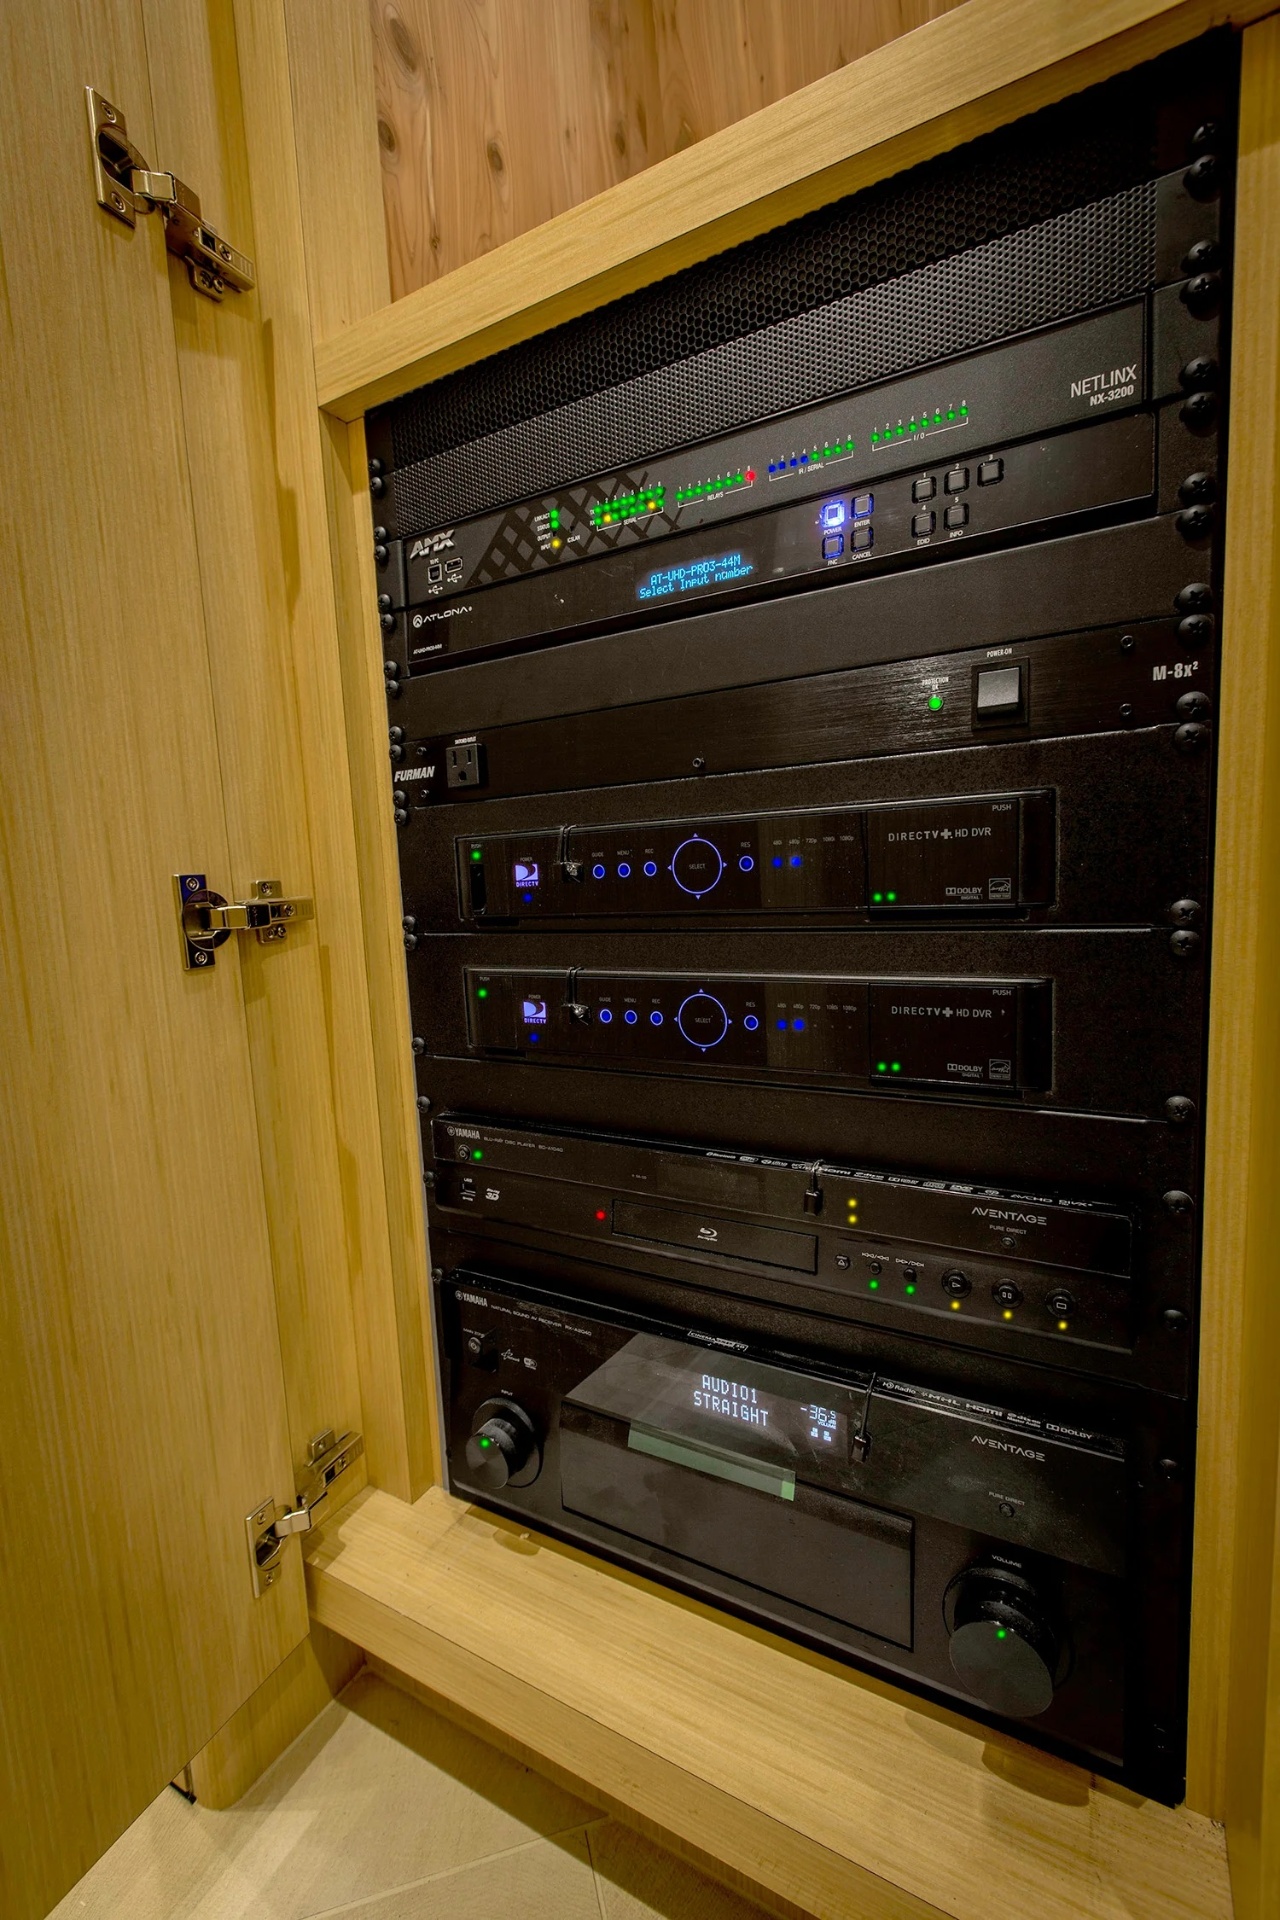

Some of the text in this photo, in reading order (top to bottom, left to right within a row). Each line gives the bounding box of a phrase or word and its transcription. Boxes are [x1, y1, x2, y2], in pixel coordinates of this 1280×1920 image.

[1070, 364, 1137, 398] NETLINX
[1090, 385, 1134, 407] NX-3200
[807, 462, 825, 473] SERIAL
[707, 491, 724, 501] RELAYS
[854, 519, 870, 528] ENTER
[823, 526, 842, 535] POWER
[949, 530, 963, 538] INFO
[409, 529, 455, 559] AMX
[852, 551, 872, 560] CANCEL
[650, 555, 741, 586] AT-UHD-PRO3-44M
[640, 565, 753, 599] Select Input number
[423, 606, 468, 623] ATLONA
[394, 766, 435, 783] FURMAN
[992, 803, 1012, 811] PUSH
[954, 828, 969, 838] HD
[971, 827, 992, 837] DVR
[515, 881, 539, 889] DIRECTV
[956, 1009, 970, 1018] HD
[972, 1009, 993, 1018] DVR
[524, 1017, 547, 1025] DIRECTV
[958, 1064, 983, 1072] DOLBY
[454, 1128, 480, 1140] YAMAHA
[971, 1206, 1047, 1226] AVENTAGE
[462, 1292, 488, 1307] YAMAHA
[702, 1374, 757, 1404] AUDIO1
[894, 1384, 916, 1395] Radio
[927, 1393, 961, 1406] MHL
[693, 1391, 769, 1427] STRAIGHT
[1060, 1426, 1093, 1440] DOLBY
[971, 1435, 1046, 1462] AVENTAGE
[991, 1554, 1022, 1569] VOLUME
